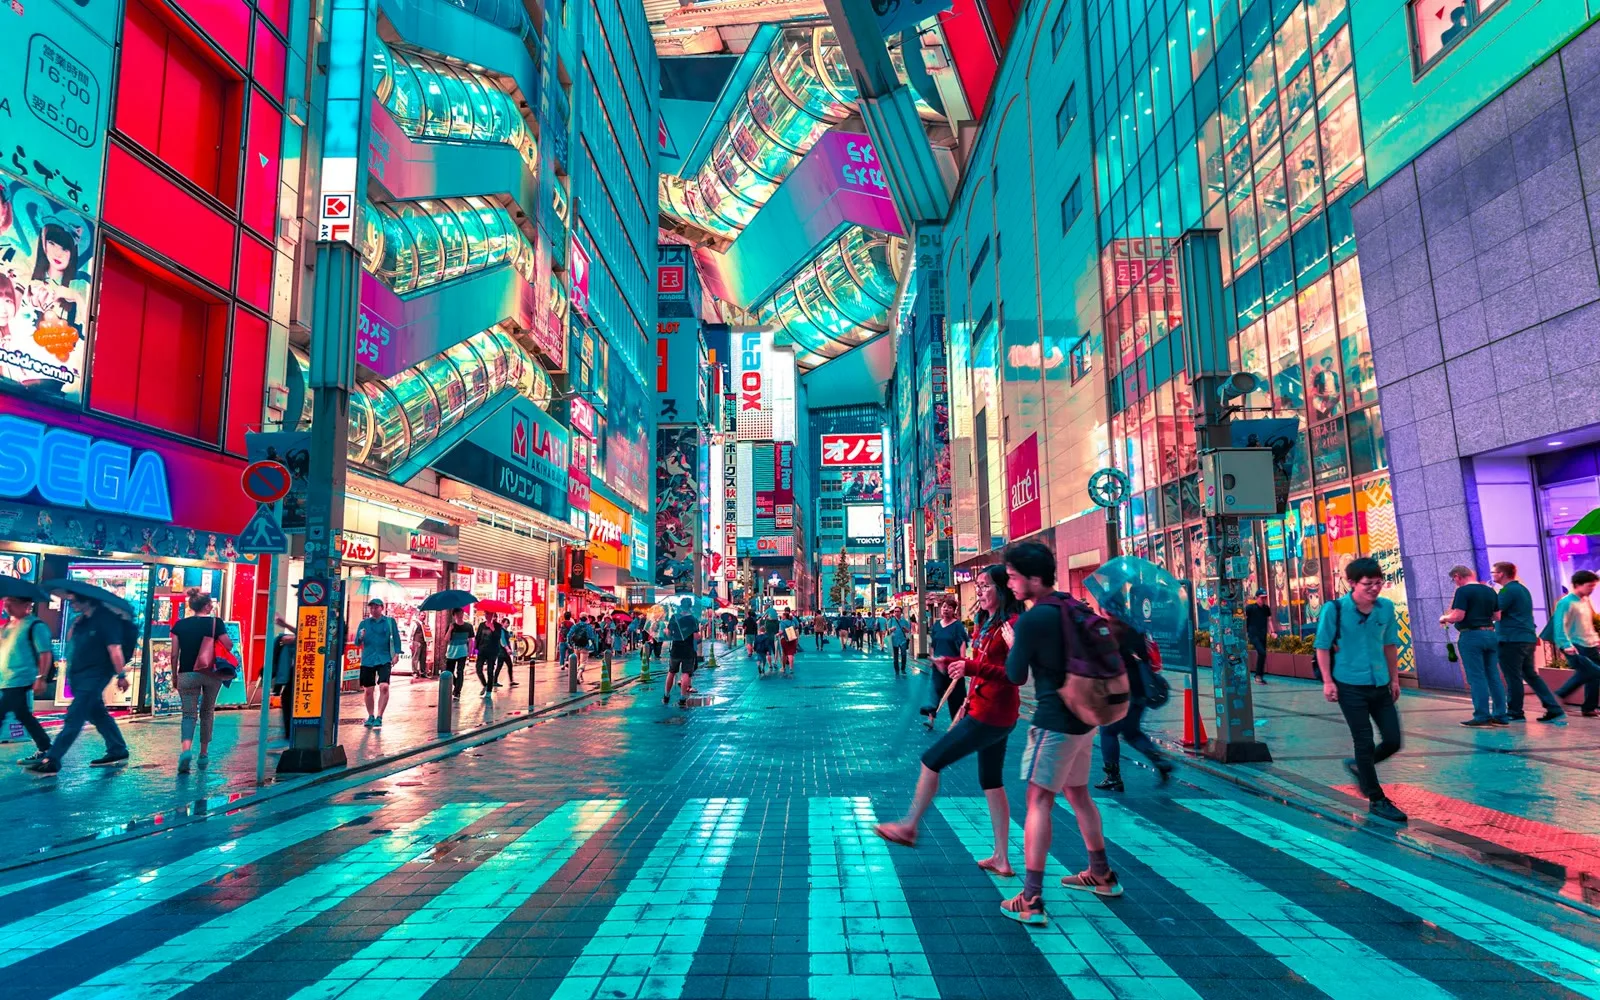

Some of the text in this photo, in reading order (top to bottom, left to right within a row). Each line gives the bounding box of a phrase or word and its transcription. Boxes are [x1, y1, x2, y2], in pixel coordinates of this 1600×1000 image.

[39, 57, 90, 105] 16:00
[43, 44, 90, 87] 営業時間
[32, 94, 89, 142] 翌5:00
[359, 313, 390, 346] カメラ
[0, 413, 173, 522] SEGA
[532, 421, 569, 473] LABI
[780, 444, 792, 490] Duty Free
[1011, 468, 1033, 509] atré
[419, 533, 438, 550] LABI
[855, 537, 881, 545] TOKYO
[301, 614, 318, 714] 路上喫煙禁止です。
[347, 648, 362, 660] au
